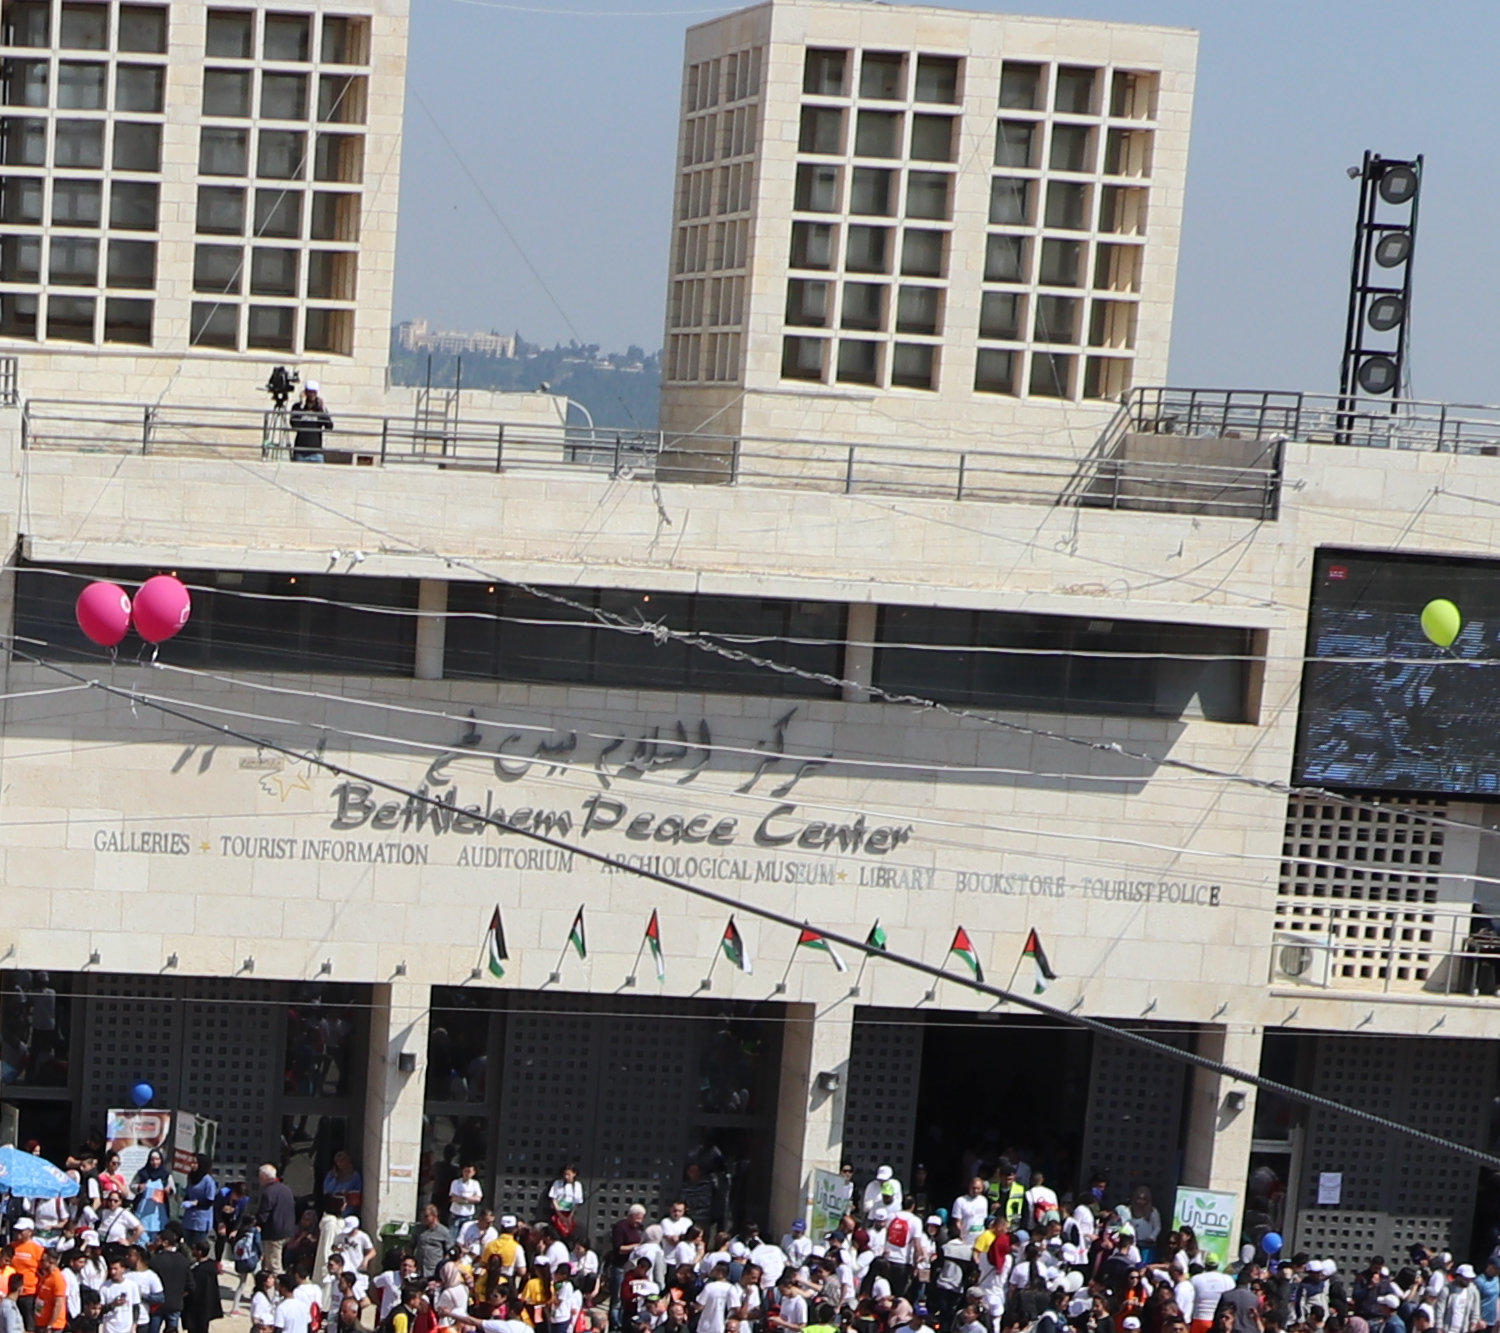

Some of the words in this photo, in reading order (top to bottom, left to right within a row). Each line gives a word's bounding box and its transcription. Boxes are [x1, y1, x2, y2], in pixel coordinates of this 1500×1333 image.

[330, 780, 573, 838] Bethlehem
[581, 793, 739, 846] Peace
[753, 802, 914, 857] Center
[93, 830, 192, 856] GALLERIES
[219, 833, 299, 861] TOURIST
[300, 836, 430, 866] INFORMATION
[456, 845, 575, 874] AUDITORIUM
[753, 857, 836, 886] MUSEUM
[858, 865, 937, 891] LIBRARY
[956, 871, 1066, 898] BOOKSTORE
[1081, 876, 1157, 902] TOURIST
[1157, 879, 1222, 908] POLICE
